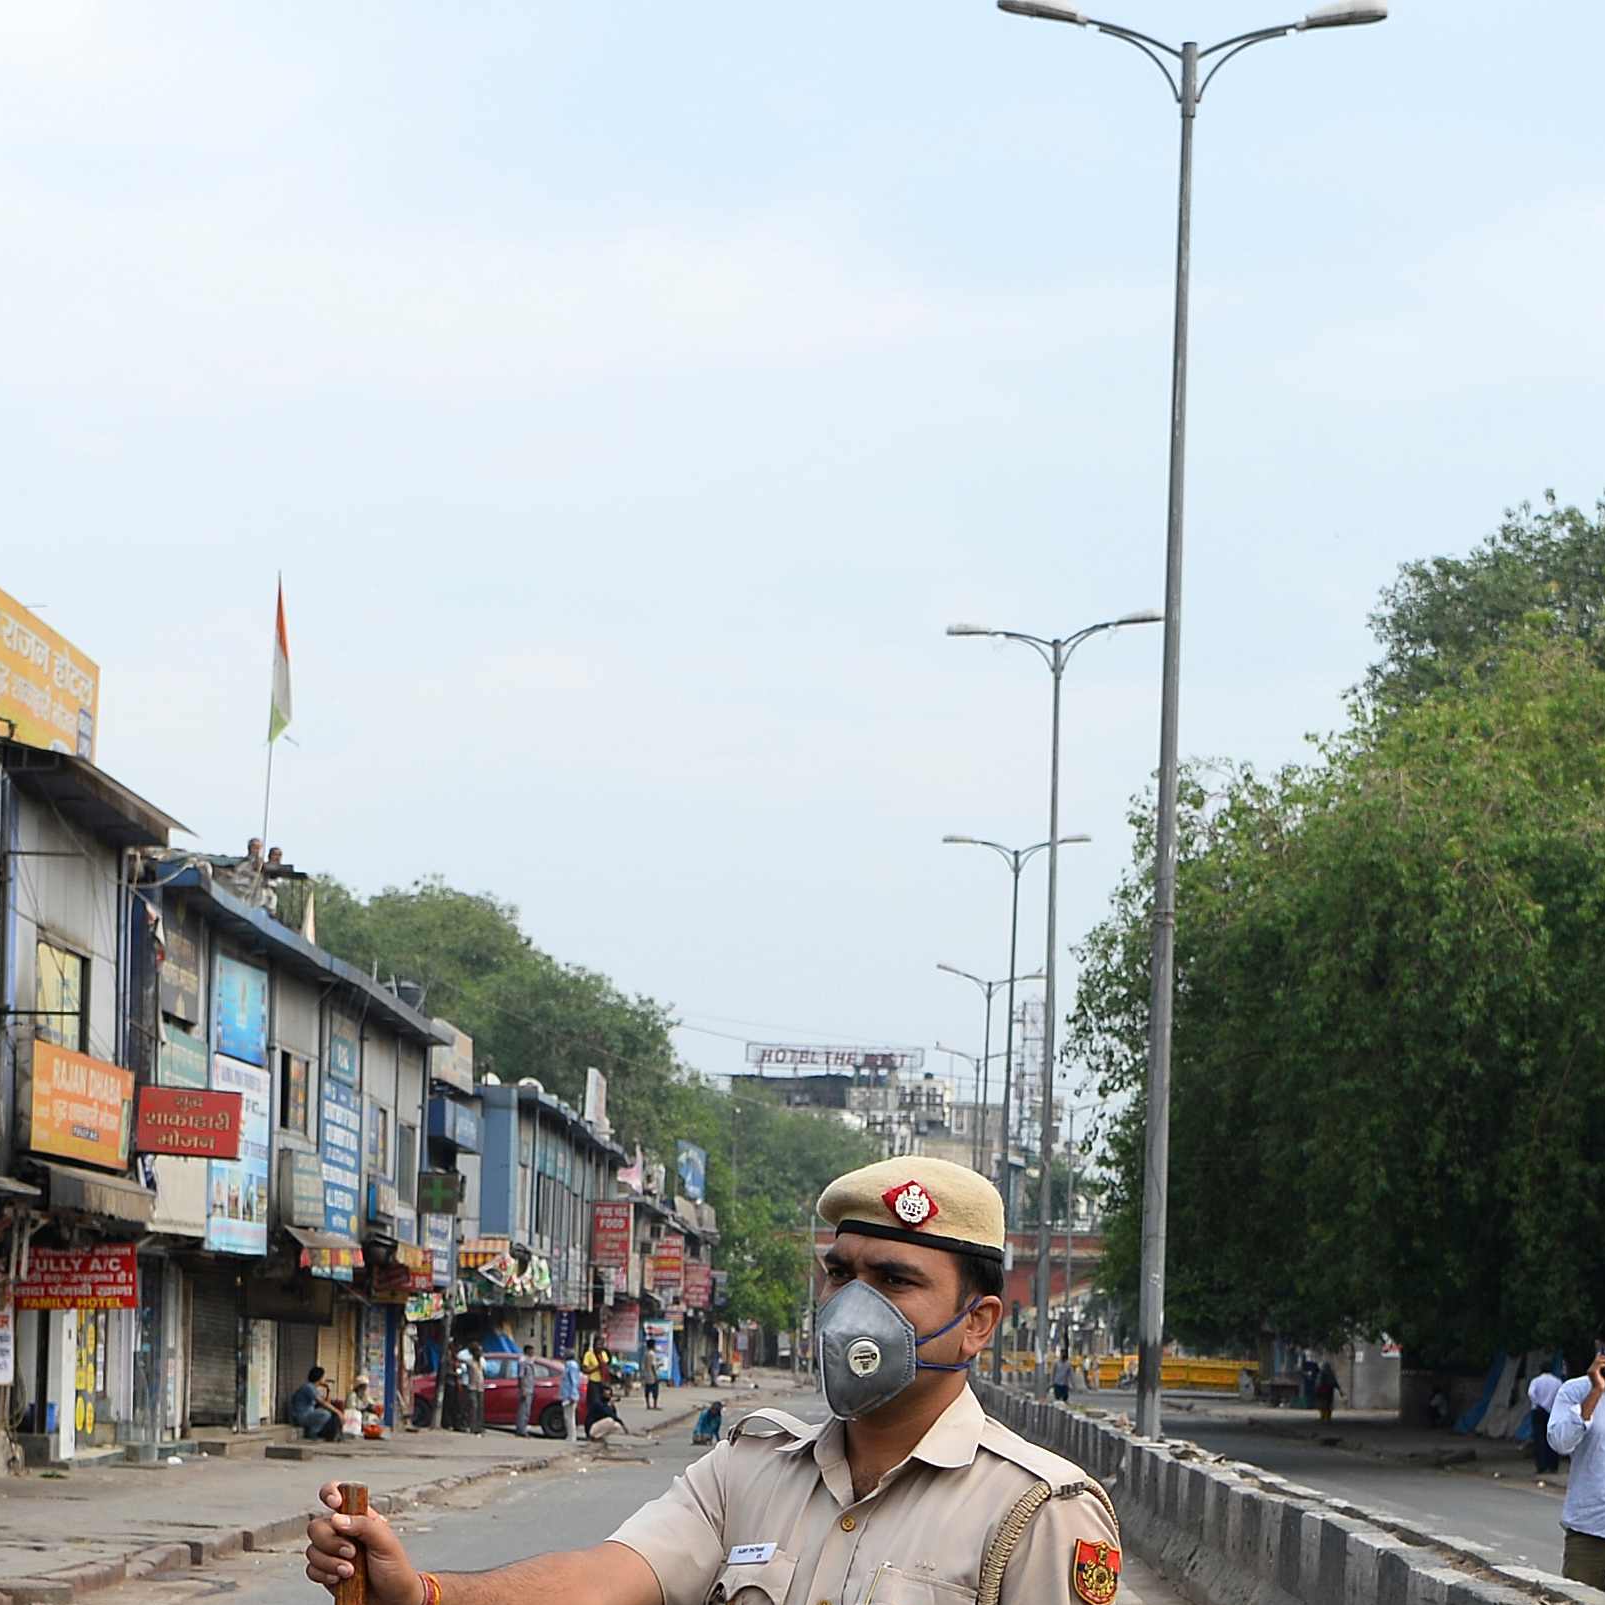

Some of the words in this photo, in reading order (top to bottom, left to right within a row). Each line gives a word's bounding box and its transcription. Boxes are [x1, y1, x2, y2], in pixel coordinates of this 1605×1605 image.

[761, 1049, 818, 1064] HOTEL
[825, 1051, 857, 1066] THE
[600, 1219, 626, 1230] FOOD
[90, 1257, 122, 1272] A/C
[22, 1297, 73, 1309] FAMILY
[76, 1297, 124, 1309] HOTEL
